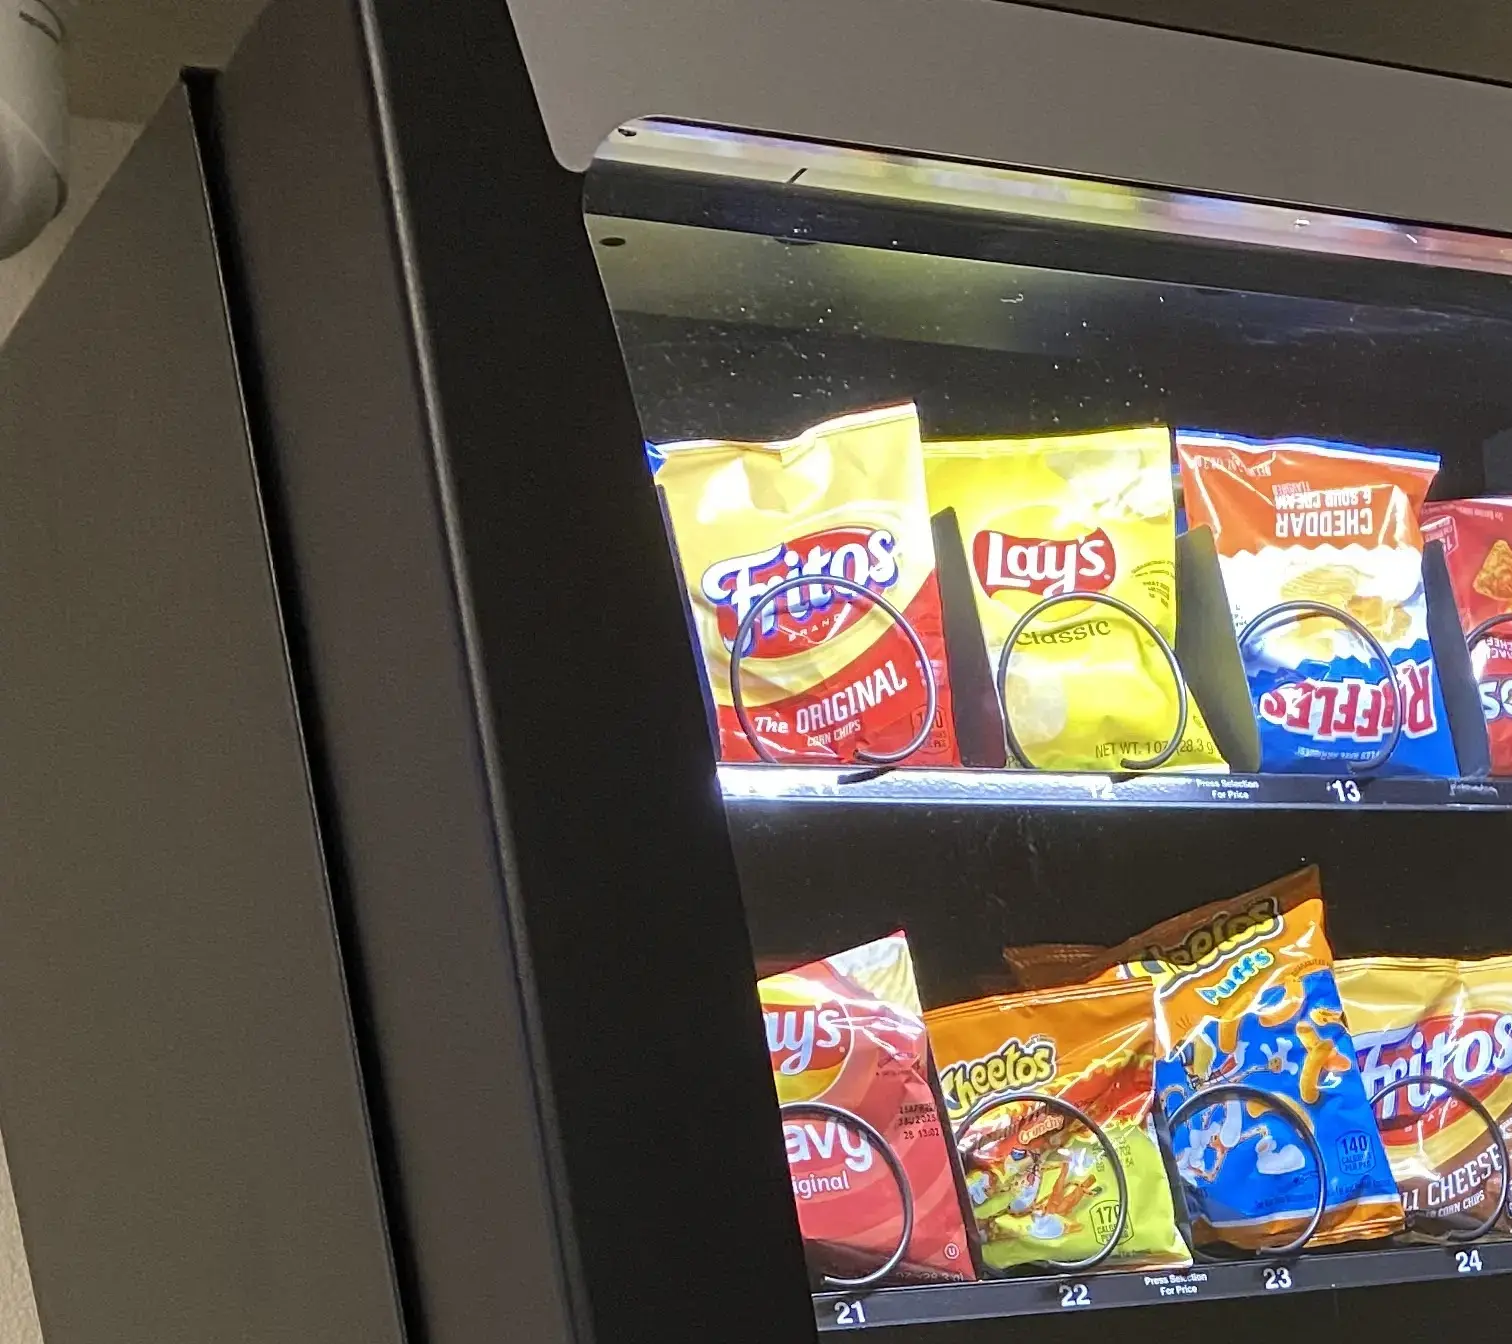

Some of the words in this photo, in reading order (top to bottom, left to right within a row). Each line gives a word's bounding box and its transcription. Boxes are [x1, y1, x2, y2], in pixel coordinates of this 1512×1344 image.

[1275, 507, 1374, 538] CHEDDAR
[986, 531, 1112, 597] Lay's
[701, 528, 898, 659] Fritos
[1015, 619, 1112, 647] Classic
[754, 715, 790, 735] The
[796, 660, 908, 735] ORIGINAL
[1261, 660, 1436, 740] RUFFLES
[833, 719, 862, 742] CHIPS
[1095, 744, 1116, 759] NET
[1227, 789, 1249, 799] Price
[1330, 778, 1362, 802] 13
[1196, 948, 1275, 1006] Puffs
[941, 1040, 1056, 1113] Cheetos
[1019, 1114, 1065, 1144] Crunchy
[784, 1117, 875, 1173] avy
[1342, 1134, 1368, 1155] 140
[792, 1171, 851, 1201] iginal
[1427, 1143, 1503, 1206] CHEESE
[1437, 1201, 1461, 1218] CORN
[1462, 1189, 1485, 1210] CHIPS
[1455, 1250, 1482, 1272] 24
[1144, 1274, 1167, 1286] Press
[1160, 1285, 1175, 1296] For
[1176, 1284, 1198, 1295] Price
[1263, 1267, 1292, 1290] 23
[1059, 1284, 1091, 1307] 22
[834, 1302, 866, 1324] 21
